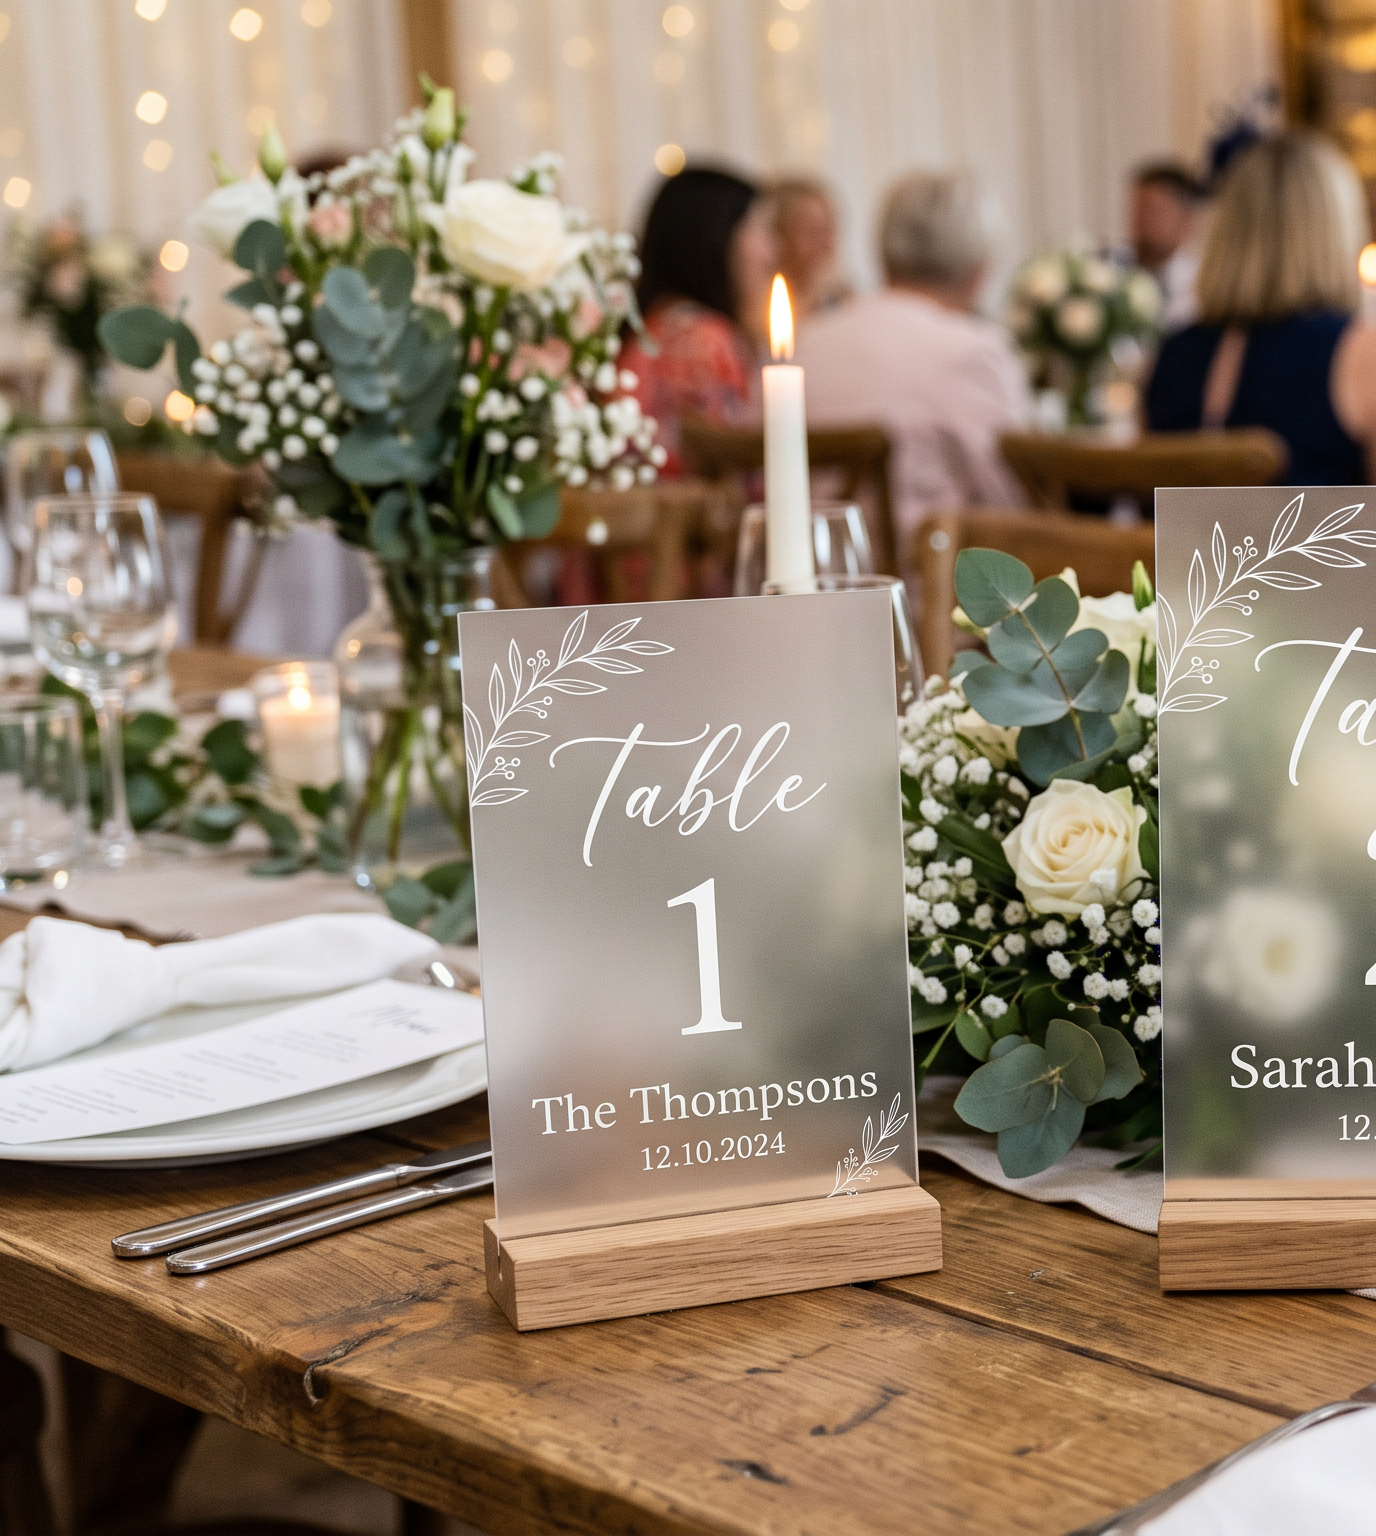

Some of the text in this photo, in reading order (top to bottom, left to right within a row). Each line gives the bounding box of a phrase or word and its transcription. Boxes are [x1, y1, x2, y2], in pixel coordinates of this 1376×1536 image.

[548, 721, 827, 867] Table
[667, 877, 743, 1036] 1
[531, 1071, 879, 1135] The Thompsons
[641, 1131, 786, 1171] 12.10.2024
